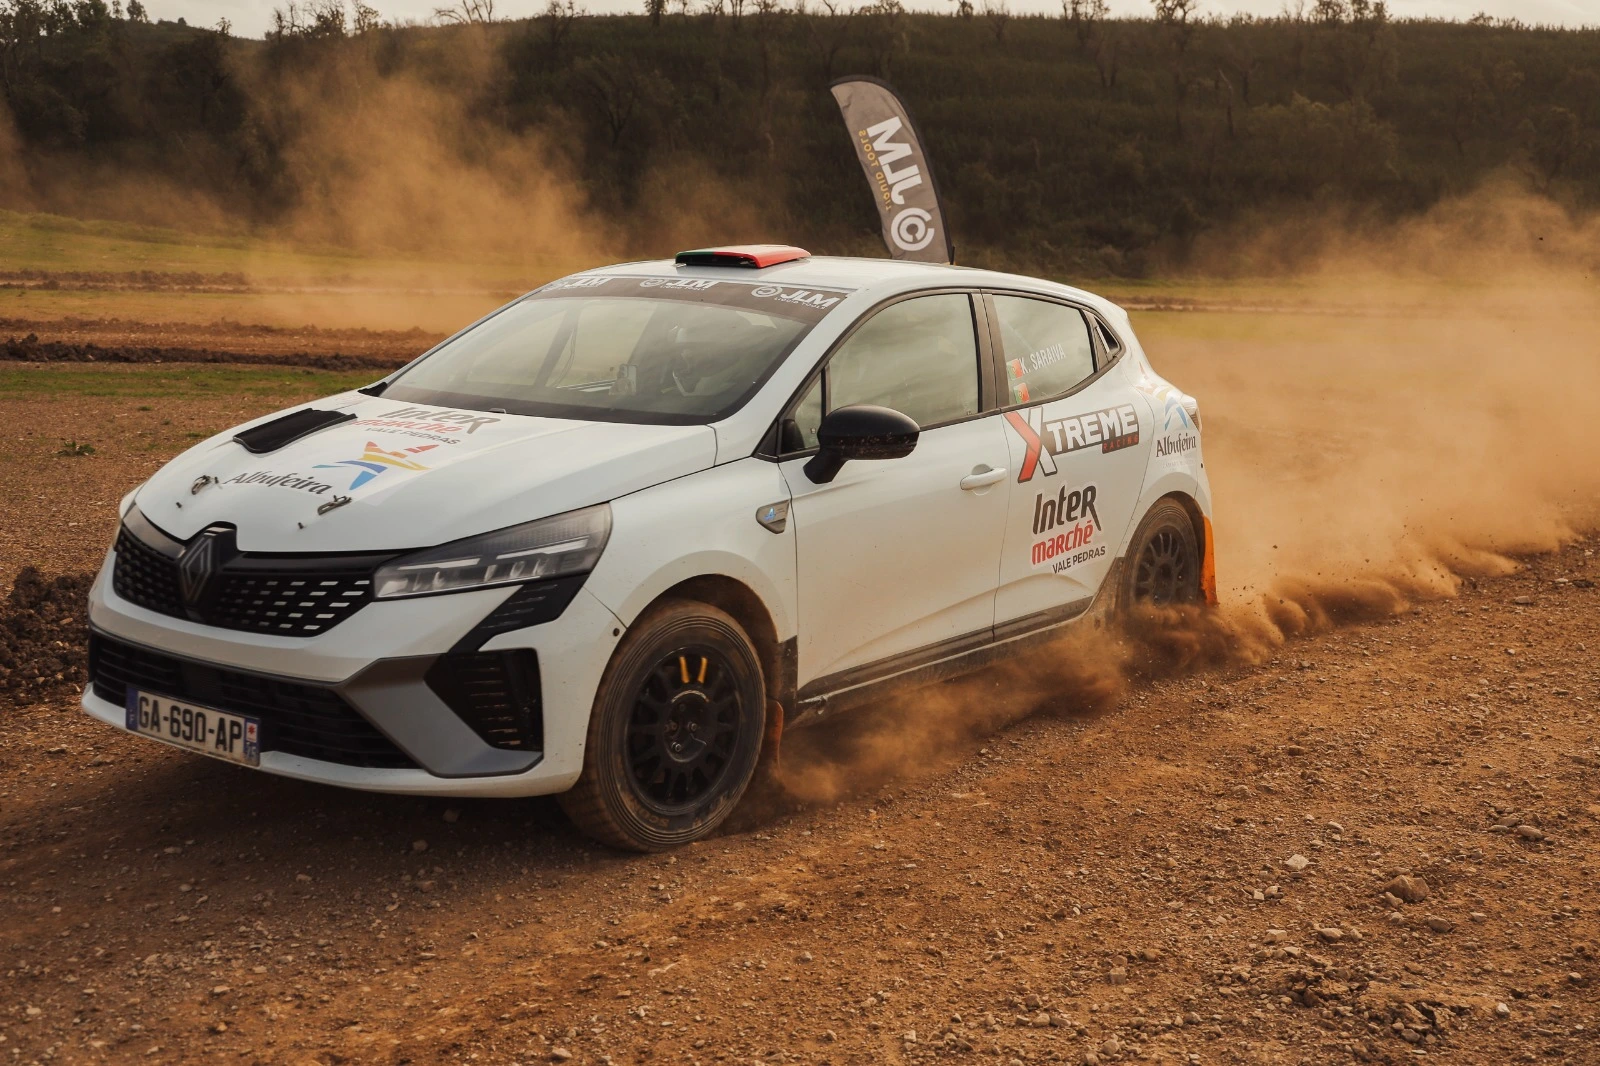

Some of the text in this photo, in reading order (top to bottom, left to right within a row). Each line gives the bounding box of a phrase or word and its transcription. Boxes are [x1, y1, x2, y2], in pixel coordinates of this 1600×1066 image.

[666, 279, 720, 289] JLM
[780, 290, 840, 308] JLM
[1030, 343, 1066, 371] SARAIVA
[400, 430, 461, 445] PEDRAS
[1103, 434, 1139, 452] RACING
[1156, 432, 1197, 457] Albufeira
[222, 471, 332, 495] Albufeira
[1052, 546, 1106, 574] VALE PEDRAS
